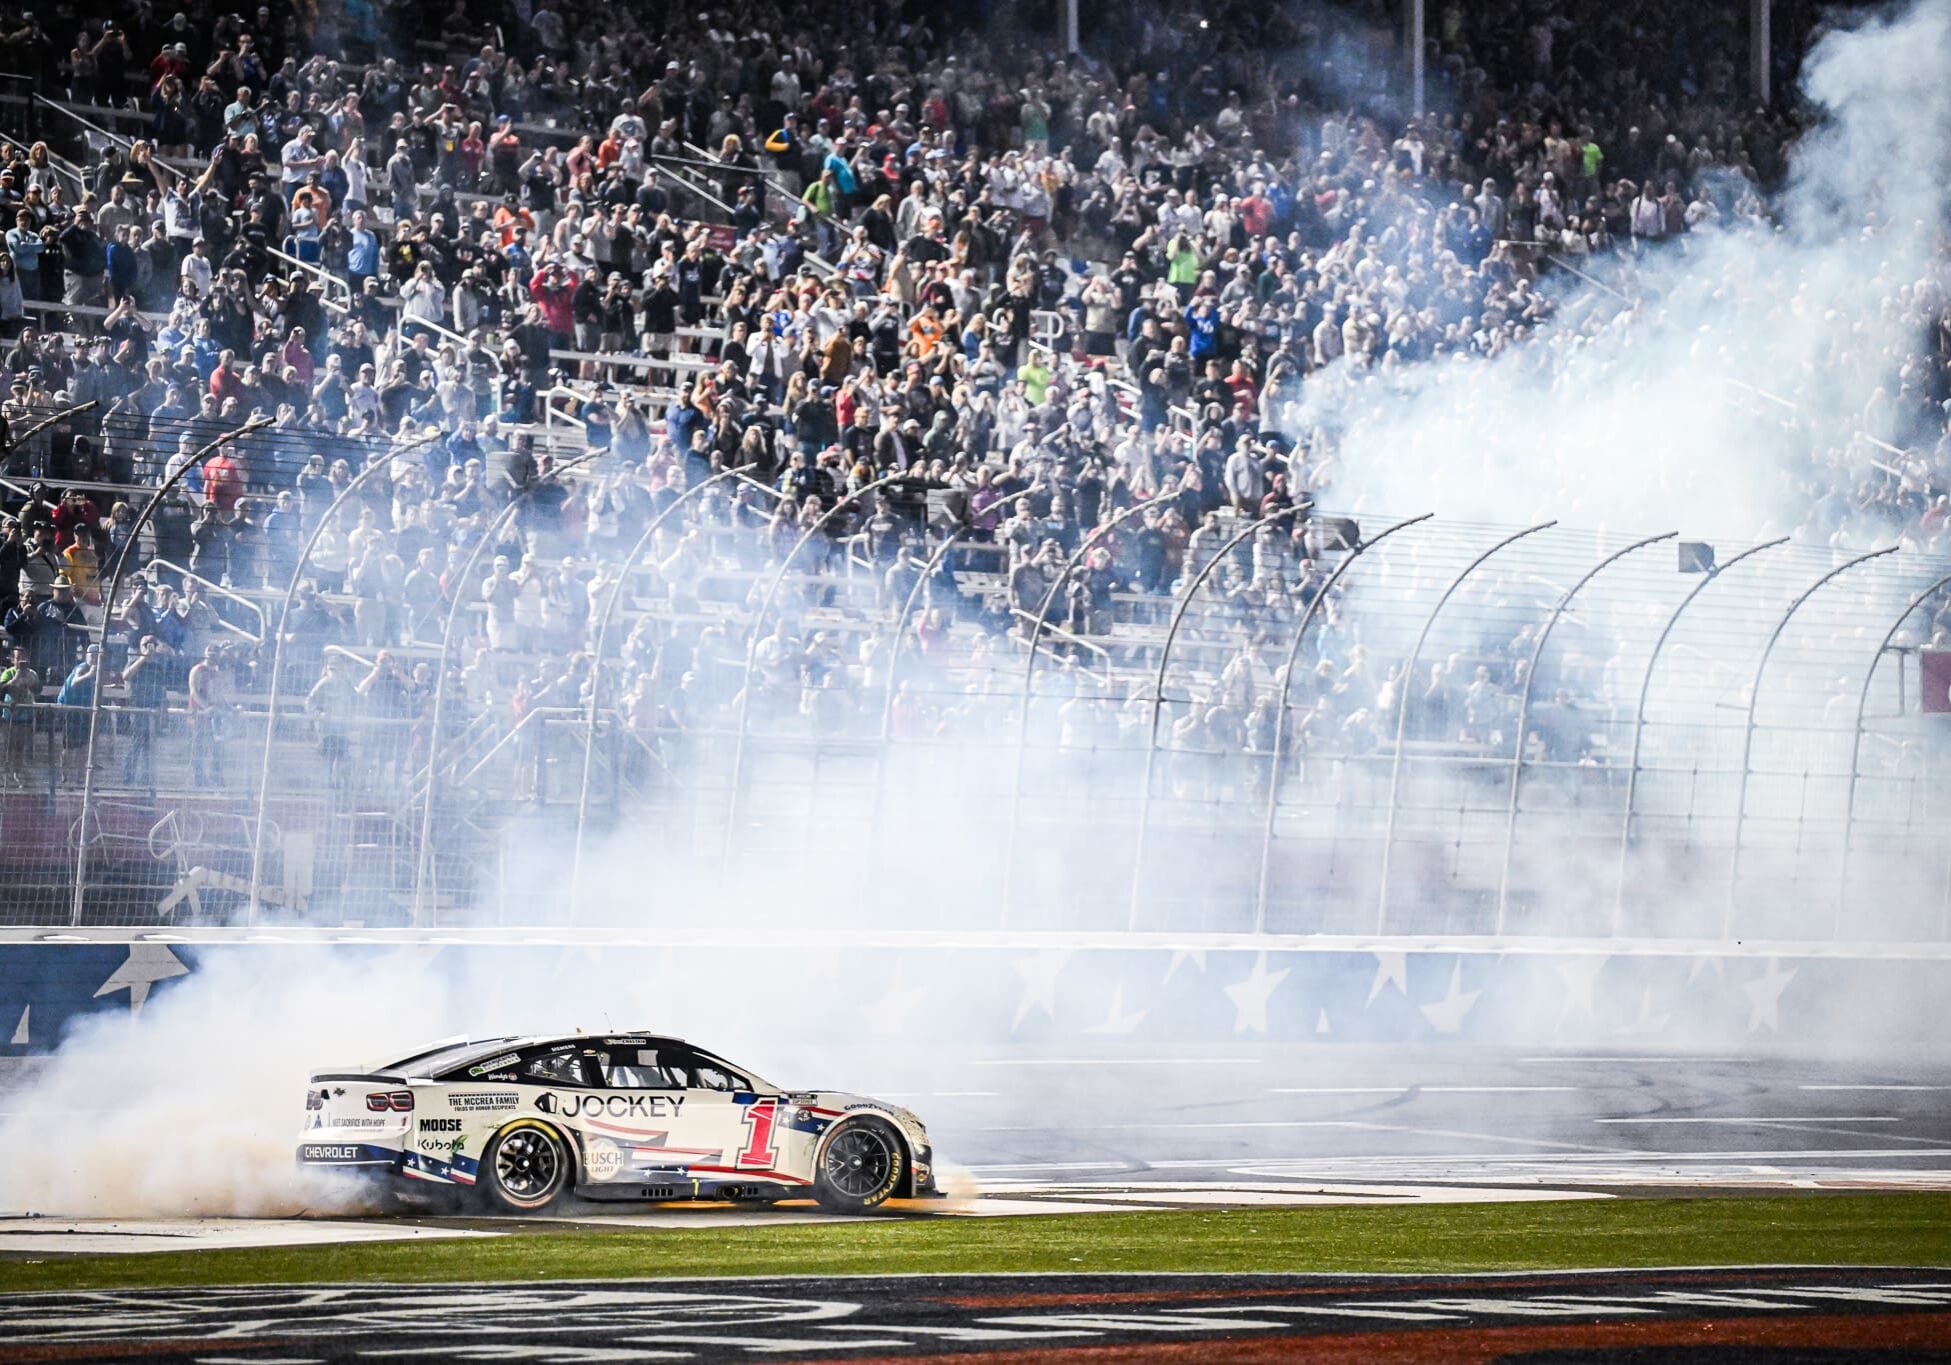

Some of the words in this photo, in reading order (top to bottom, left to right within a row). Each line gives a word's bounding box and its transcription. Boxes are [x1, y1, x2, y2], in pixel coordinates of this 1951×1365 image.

[448, 1098, 462, 1106] THE
[496, 1096, 519, 1105] FAMILY
[562, 1095, 685, 1117] JOCKEY
[844, 1103, 894, 1117] GOODYEAR
[420, 1119, 462, 1132] MOOSE
[736, 1097, 780, 1170] 1
[304, 1146, 358, 1159] CHEVROLET
[584, 1152, 624, 1166] BUSCH
[863, 1152, 902, 1206] GOODYEAR
